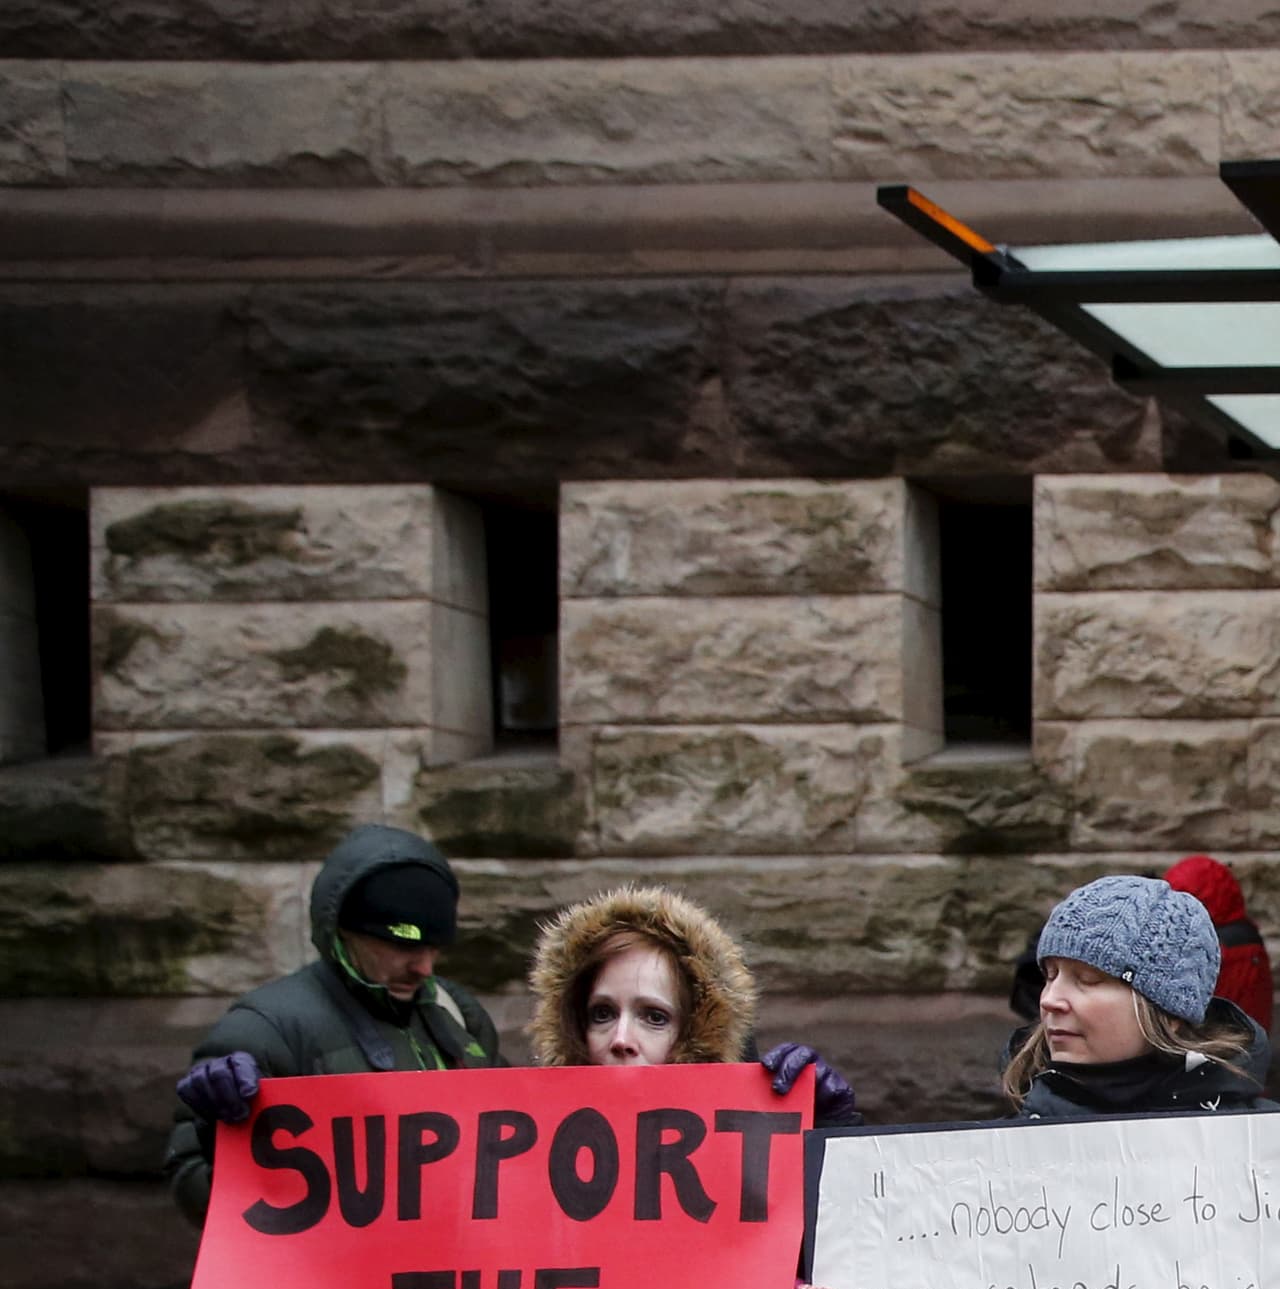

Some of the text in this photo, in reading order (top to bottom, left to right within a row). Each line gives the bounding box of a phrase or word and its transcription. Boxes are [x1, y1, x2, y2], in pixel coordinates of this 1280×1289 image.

[242, 1103, 803, 1236] SUPPORT
[1090, 1175, 1171, 1232] close
[1182, 1165, 1217, 1225] to
